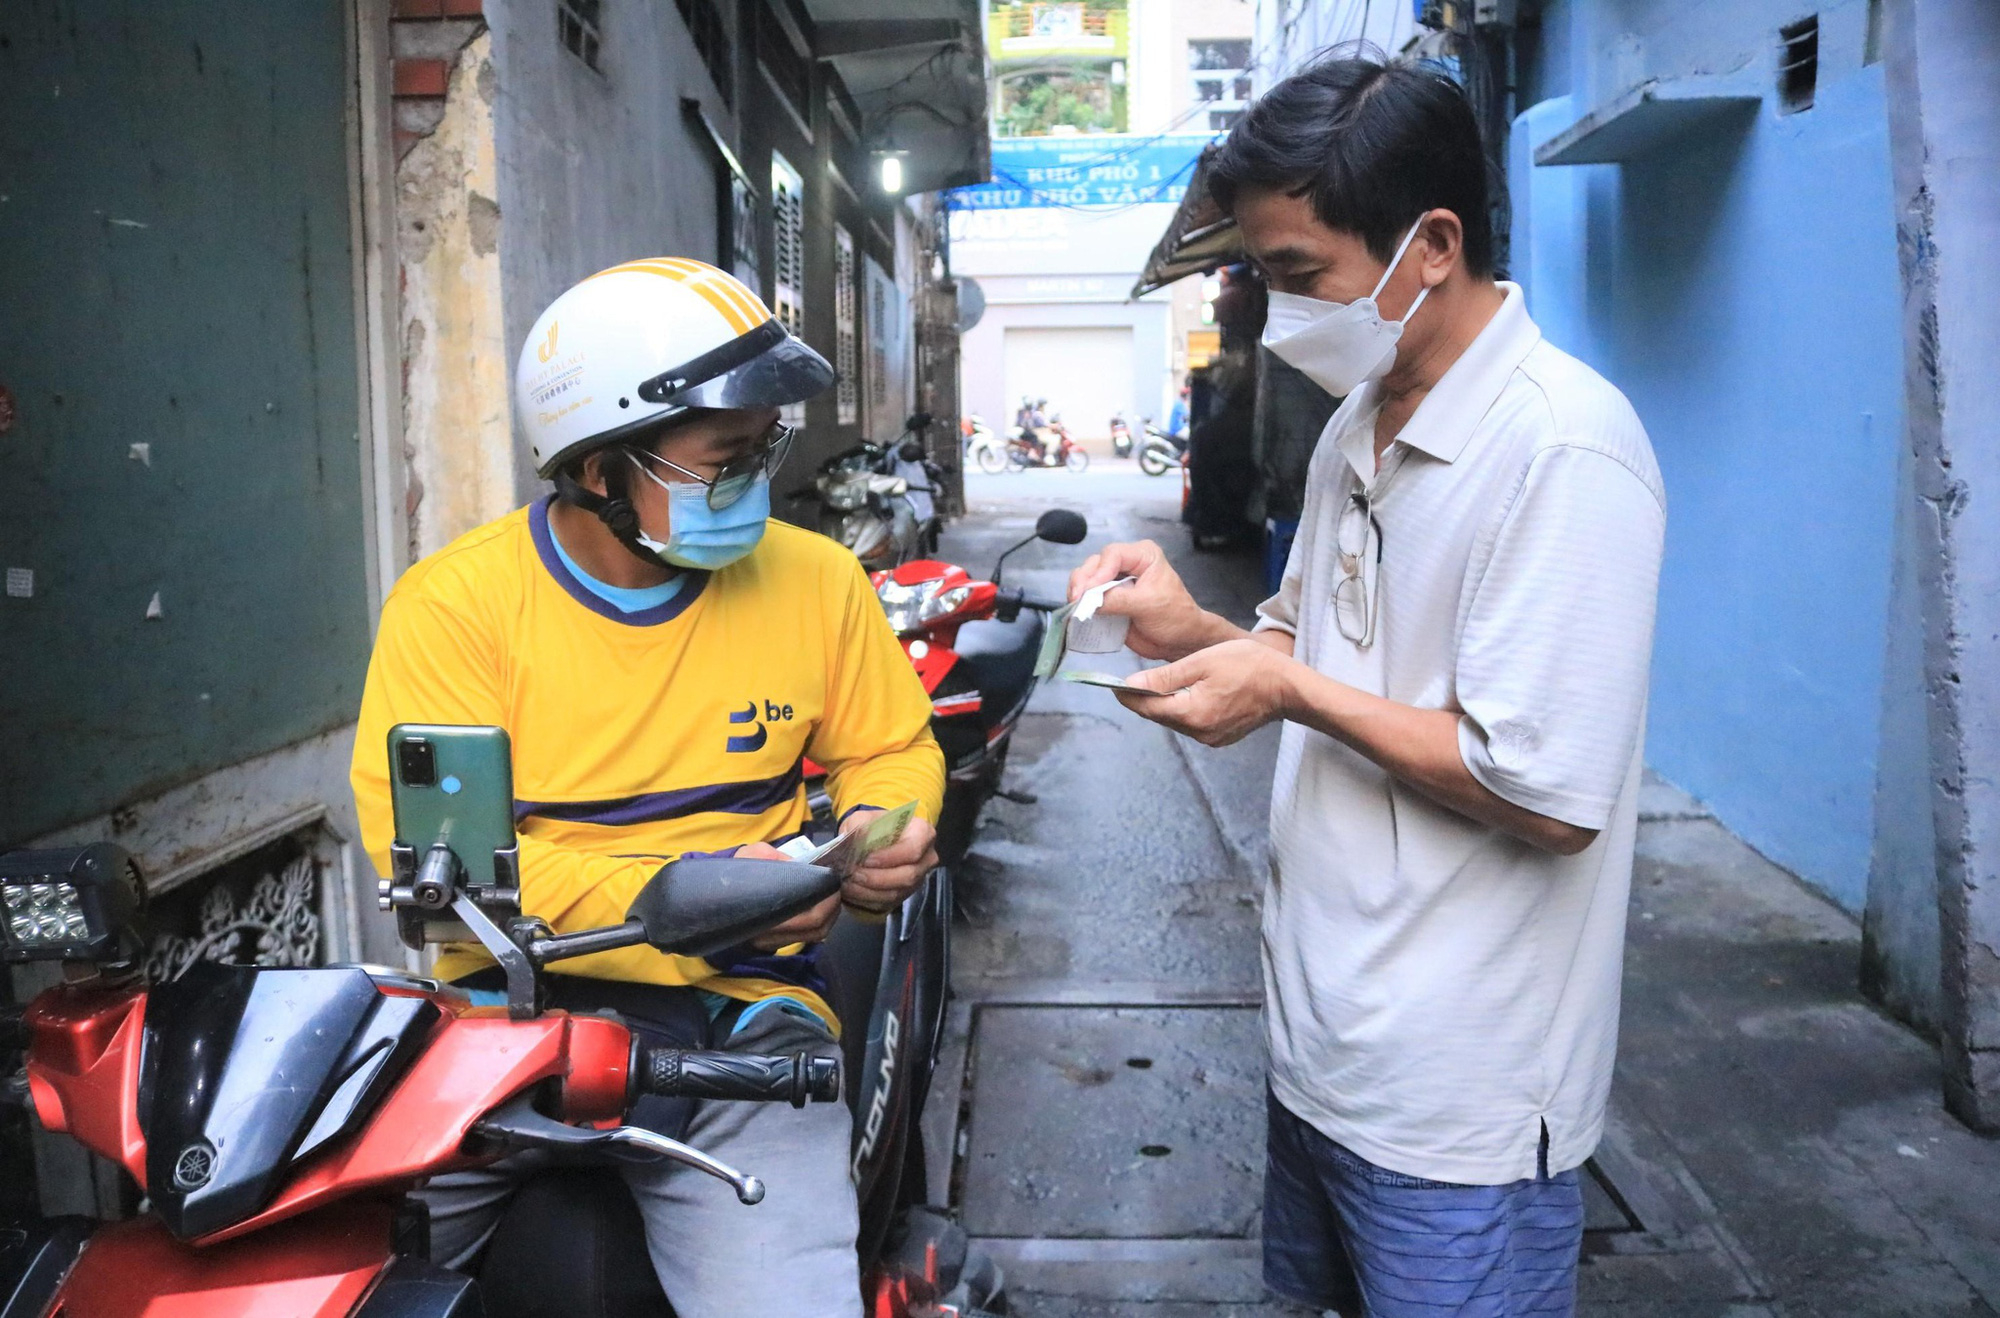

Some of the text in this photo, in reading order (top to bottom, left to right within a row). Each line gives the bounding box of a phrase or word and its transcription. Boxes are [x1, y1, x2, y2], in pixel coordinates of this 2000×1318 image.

[1028, 160, 1161, 184] KHU PHỐ 1
[764, 699, 794, 722] be
